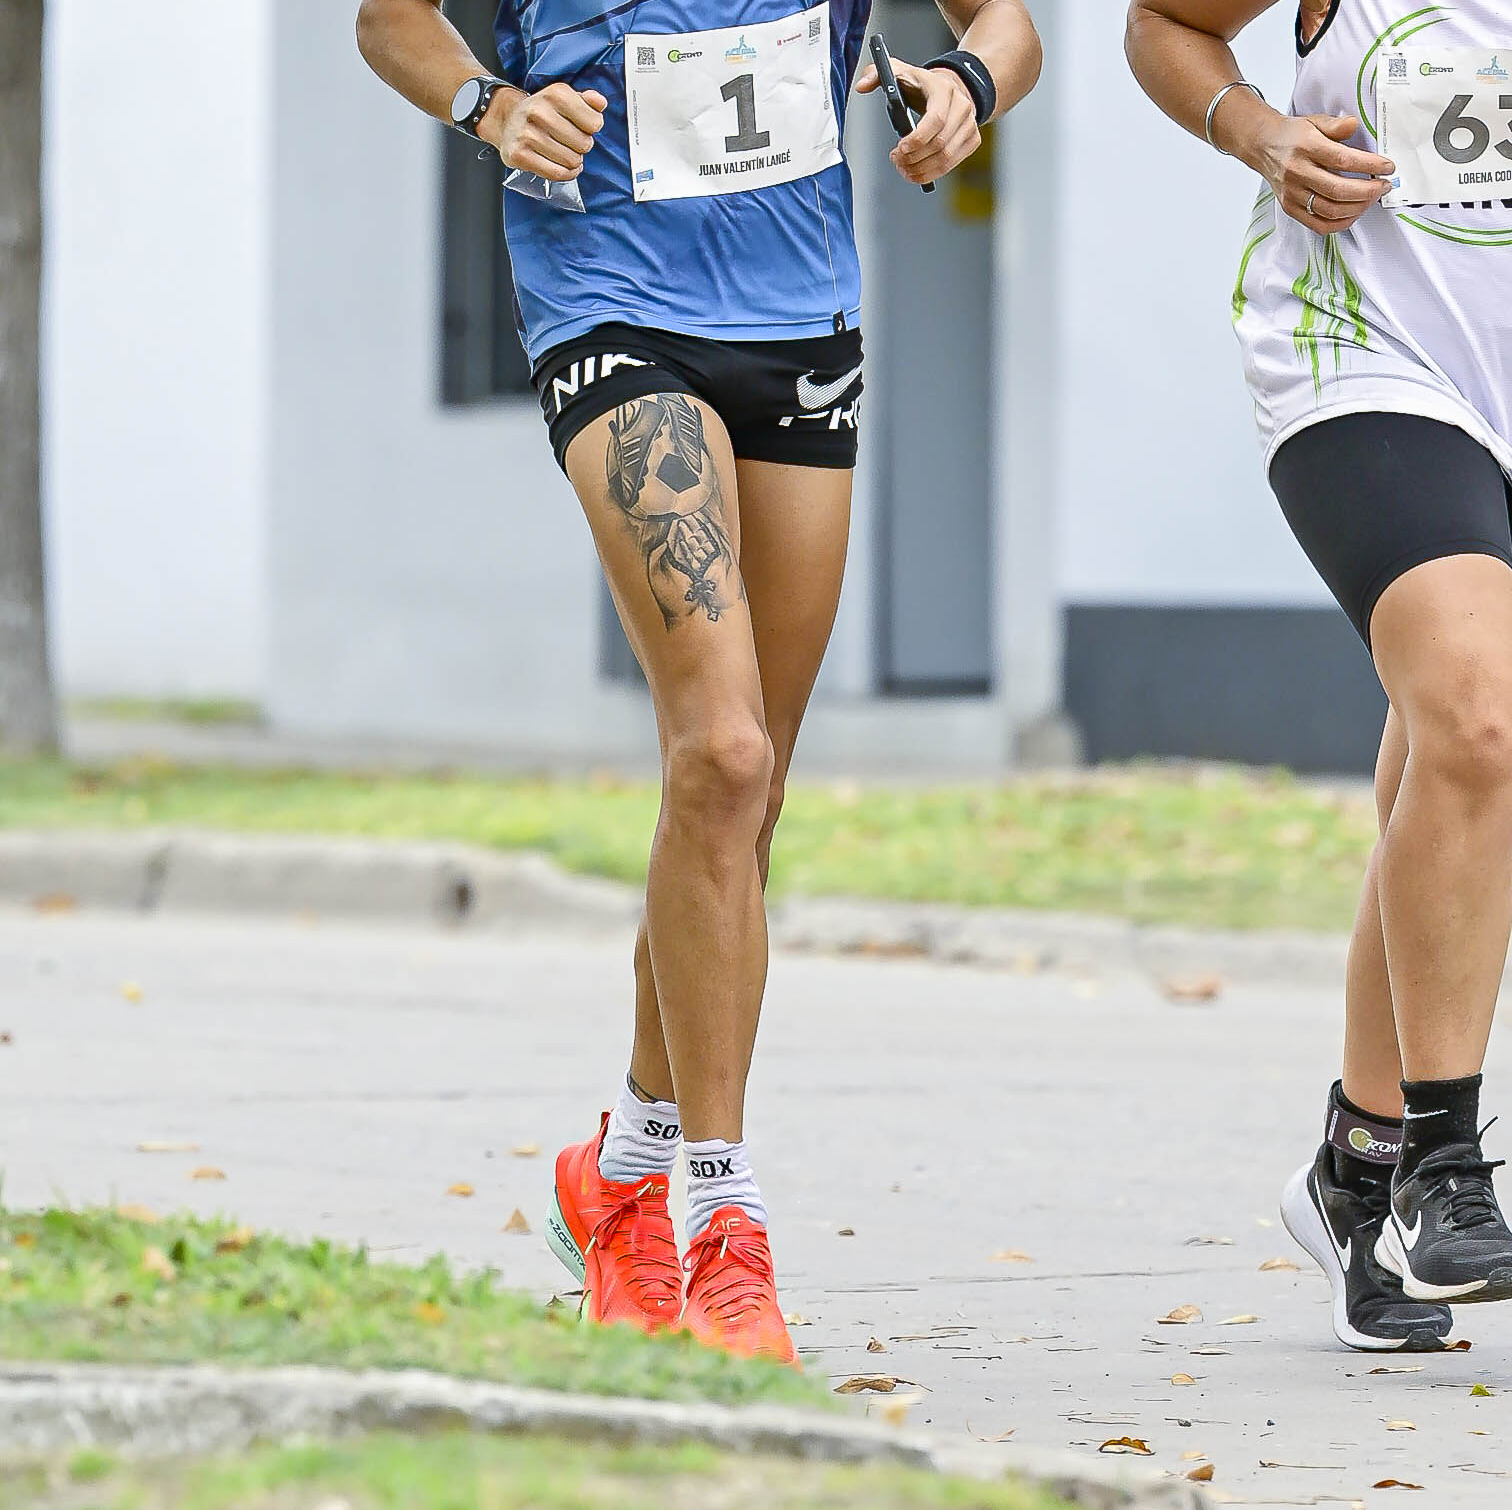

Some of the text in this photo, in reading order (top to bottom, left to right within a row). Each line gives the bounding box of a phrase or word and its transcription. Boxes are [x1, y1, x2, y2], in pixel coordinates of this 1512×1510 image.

[719, 74, 770, 153] 1
[699, 148, 792, 176] JUAN VALENTÍN LANGÉ
[1458, 171, 1493, 185] LORENA
[553, 353, 656, 414] NIK
[643, 1119, 682, 1139] SO
[689, 1157, 735, 1178] SOX
